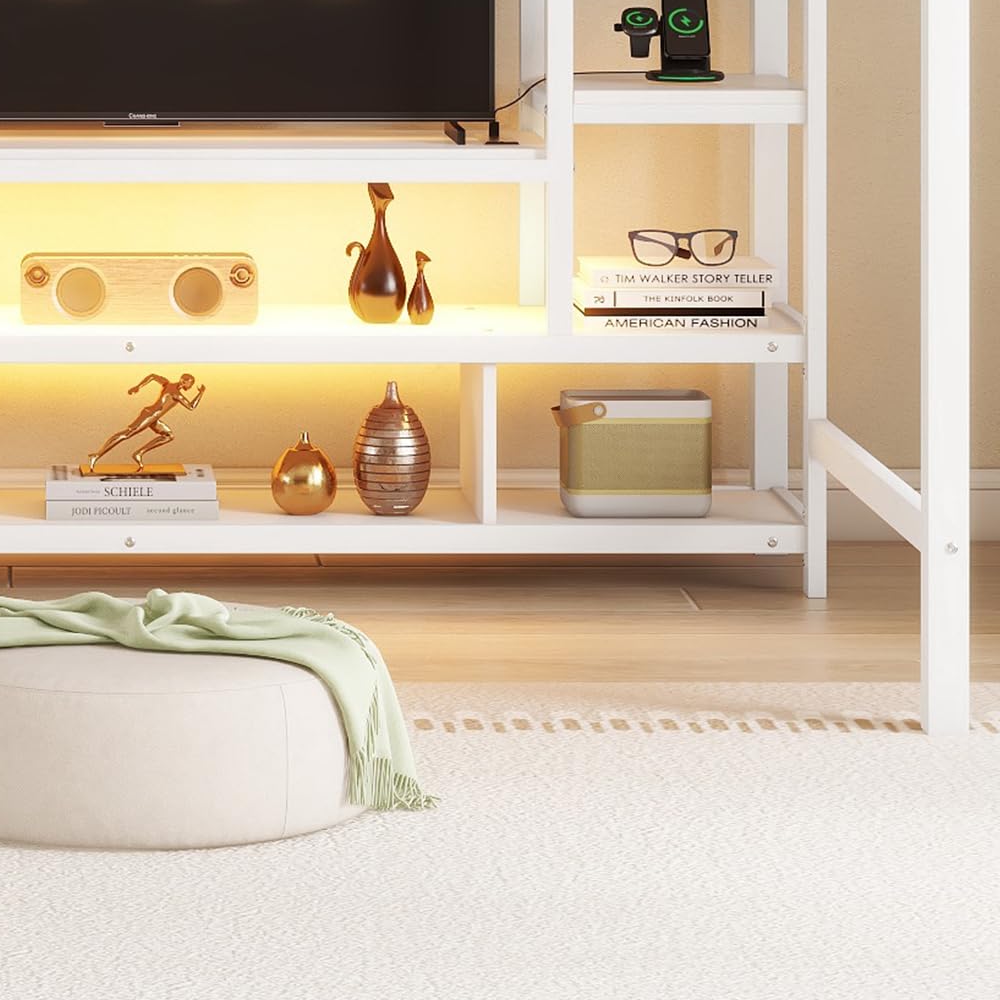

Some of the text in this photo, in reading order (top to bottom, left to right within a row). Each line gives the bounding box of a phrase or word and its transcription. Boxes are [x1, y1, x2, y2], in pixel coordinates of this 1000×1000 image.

[616, 274, 773, 284] TIM WALKER STORY TELLER
[643, 295, 734, 303] THE KINFOLK BOOK
[604, 318, 758, 328] AMERICAN FASHION
[104, 487, 153, 498] SCHIELE
[71, 507, 92, 517] JODI
[94, 507, 131, 516] PICOULT
[173, 507, 196, 515] glance
